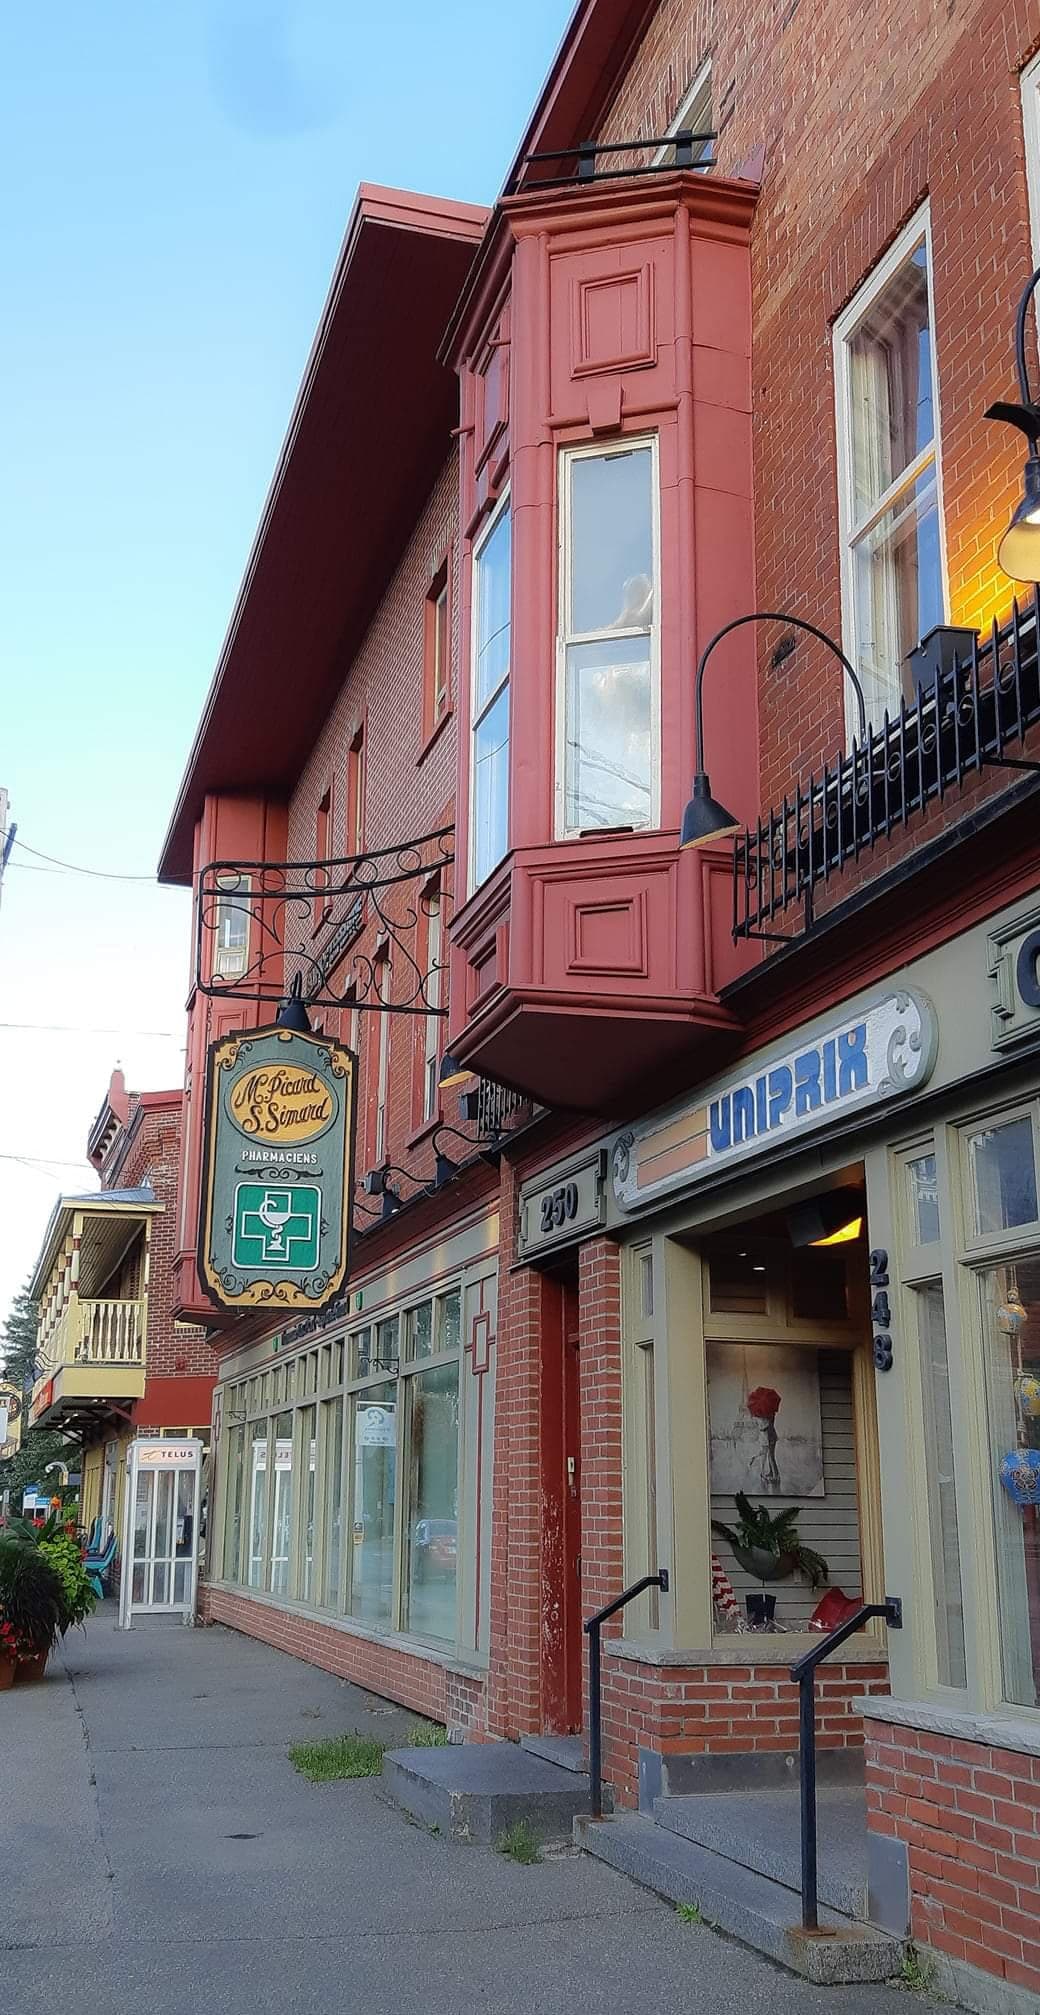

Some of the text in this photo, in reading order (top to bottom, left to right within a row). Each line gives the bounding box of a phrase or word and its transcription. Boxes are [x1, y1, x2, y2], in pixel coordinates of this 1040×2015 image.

[710, 1023, 869, 1153] UNIPRIX
[241, 1150, 318, 1164] PHARMACIENS
[540, 1182, 579, 1233] 250
[869, 1248, 893, 1372] 248
